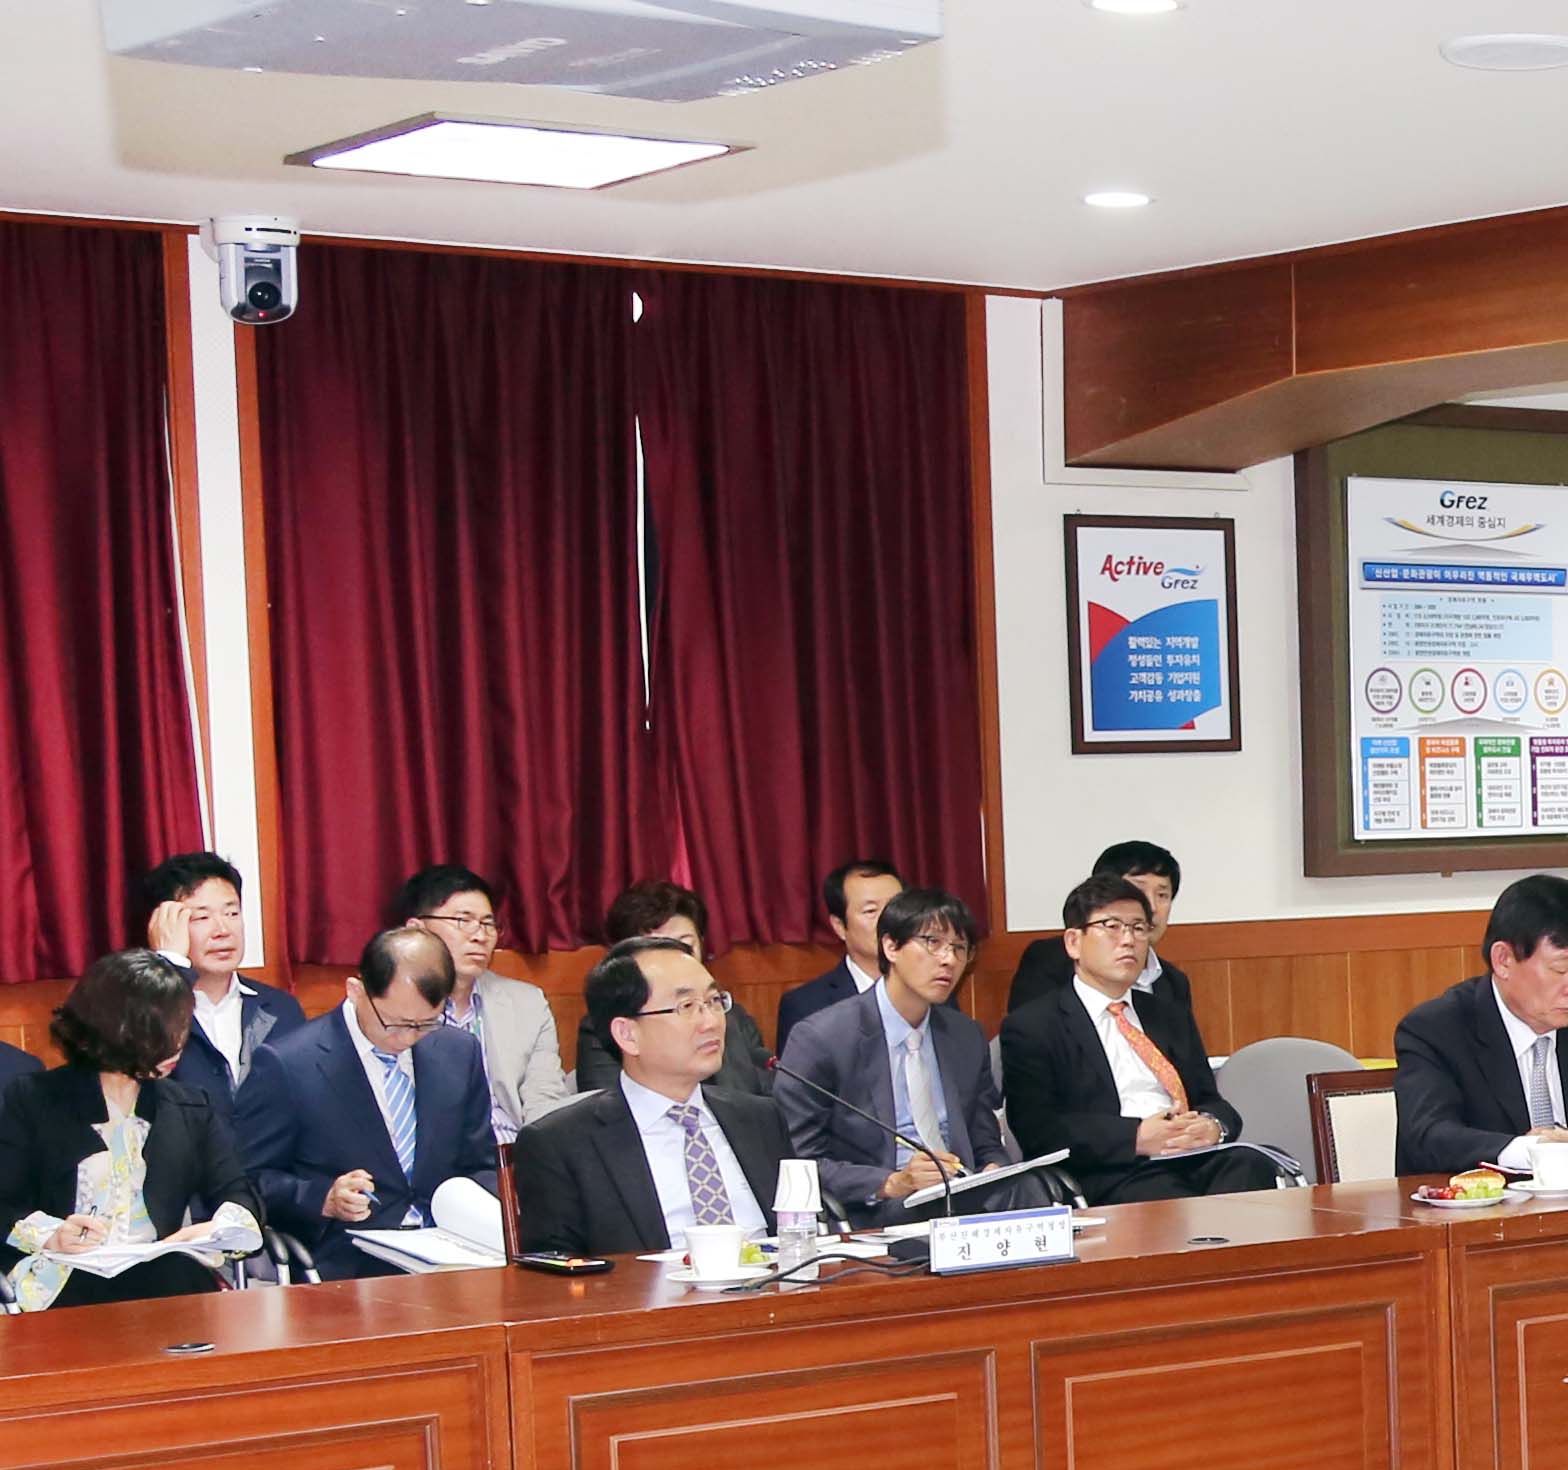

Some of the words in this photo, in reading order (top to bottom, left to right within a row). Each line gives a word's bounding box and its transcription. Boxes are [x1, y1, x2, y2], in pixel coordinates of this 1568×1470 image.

[1425, 513, 1475, 528] 세계경제의
[1477, 515, 1507, 529] 중심지
[1100, 553, 1165, 582] Active
